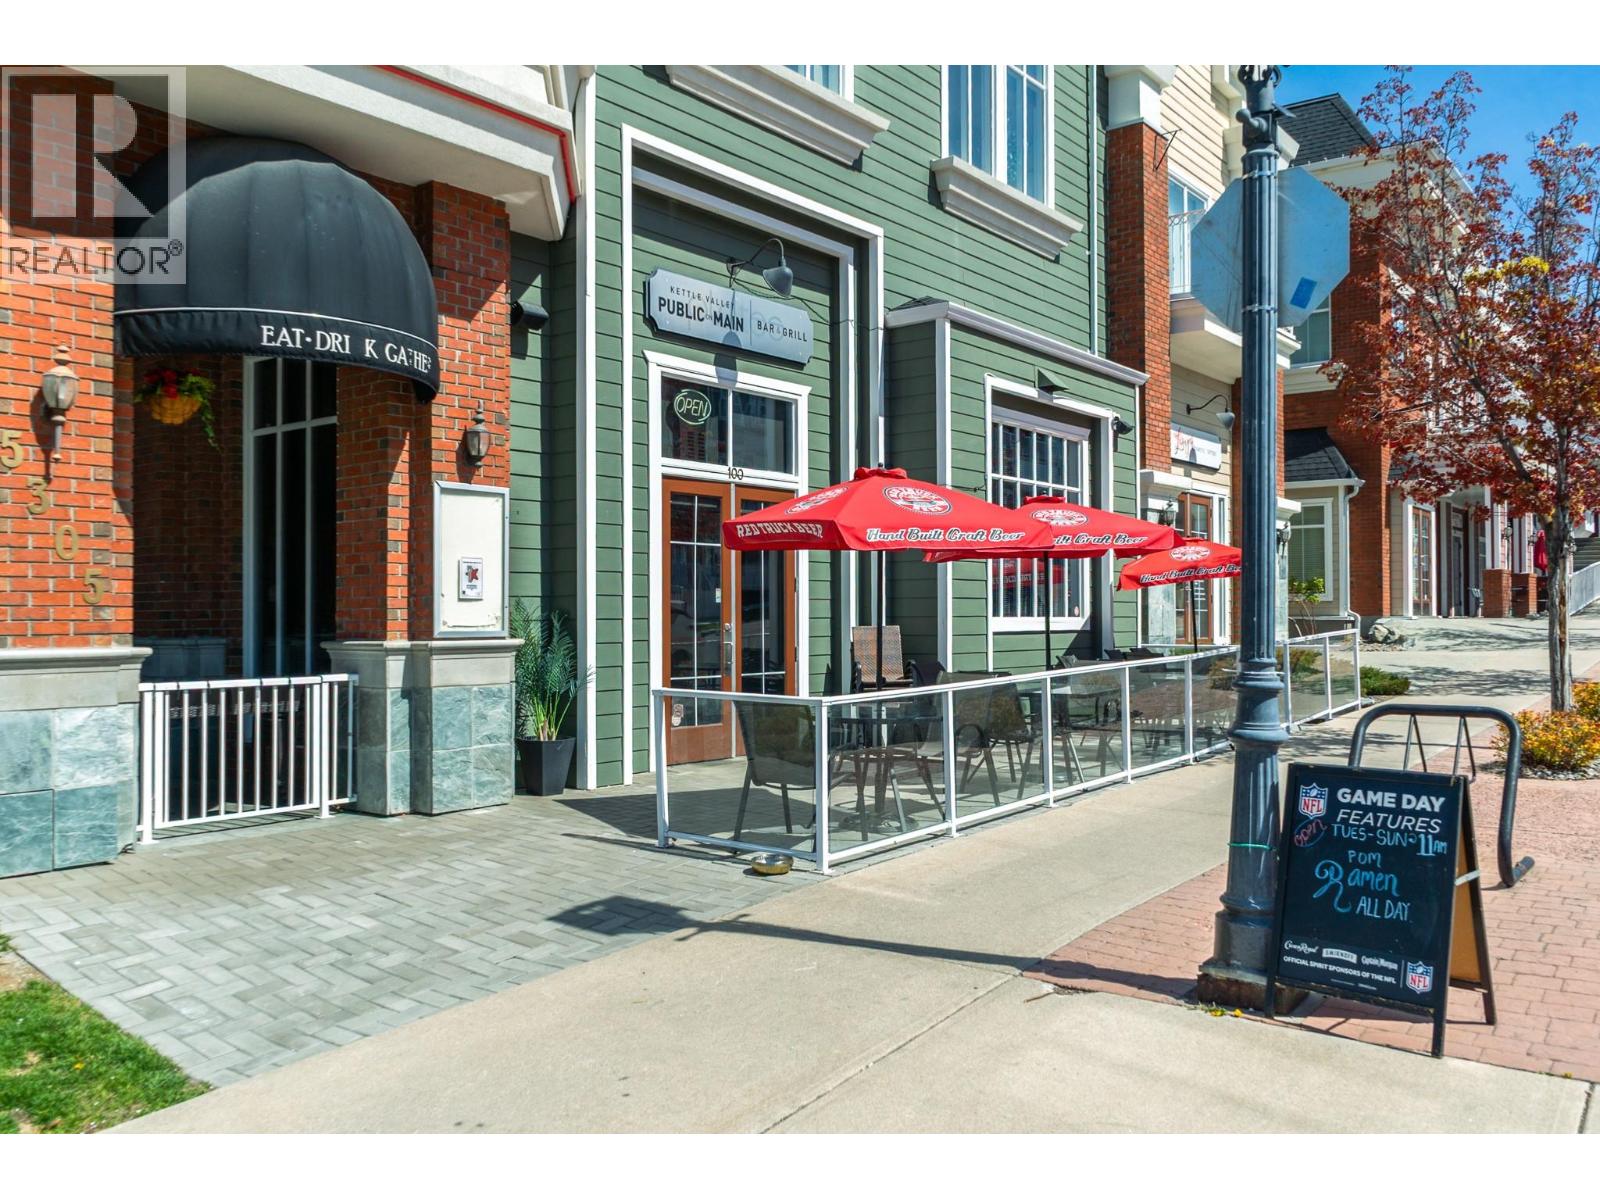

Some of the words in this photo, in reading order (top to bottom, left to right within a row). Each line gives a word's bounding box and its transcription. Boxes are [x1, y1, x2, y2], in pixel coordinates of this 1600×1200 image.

[670, 286, 702, 301] KETTLE
[658, 296, 705, 322] PUBLIC
[713, 311, 744, 332] MAIN
[757, 320, 775, 334] BAR
[782, 327, 808, 342] GRILL
[676, 396, 709, 417] OPEN
[736, 523, 760, 538] RED
[757, 522, 797, 535] TRUCK
[792, 522, 823, 538] BEER
[866, 528, 906, 541] Hand
[907, 528, 943, 541] Built
[946, 527, 986, 541] Craft
[988, 528, 1025, 541] Beer
[1074, 532, 1111, 544] Craft
[1114, 532, 1148, 544] Beer
[1140, 573, 1168, 584] Hand
[1168, 567, 1196, 579] Built
[1196, 565, 1225, 576] Craft
[1302, 798, 1323, 813] NFL
[1337, 788, 1397, 808] GAME
[1401, 794, 1446, 812] DAY
[1336, 809, 1442, 834] FEATURES
[1347, 850, 1382, 868] POM
[1312, 860, 1400, 912] Ramen
[1356, 896, 1381, 918] ALL
[1384, 900, 1410, 921] DAY
[1283, 956, 1309, 967] OFFICIAL
[1309, 961, 1328, 970] SPIRIT
[1328, 964, 1360, 977] SPONSORS
[1370, 973, 1384, 982] THE
[1383, 976, 1397, 984] NFL
[1410, 975, 1428, 989] NFL
